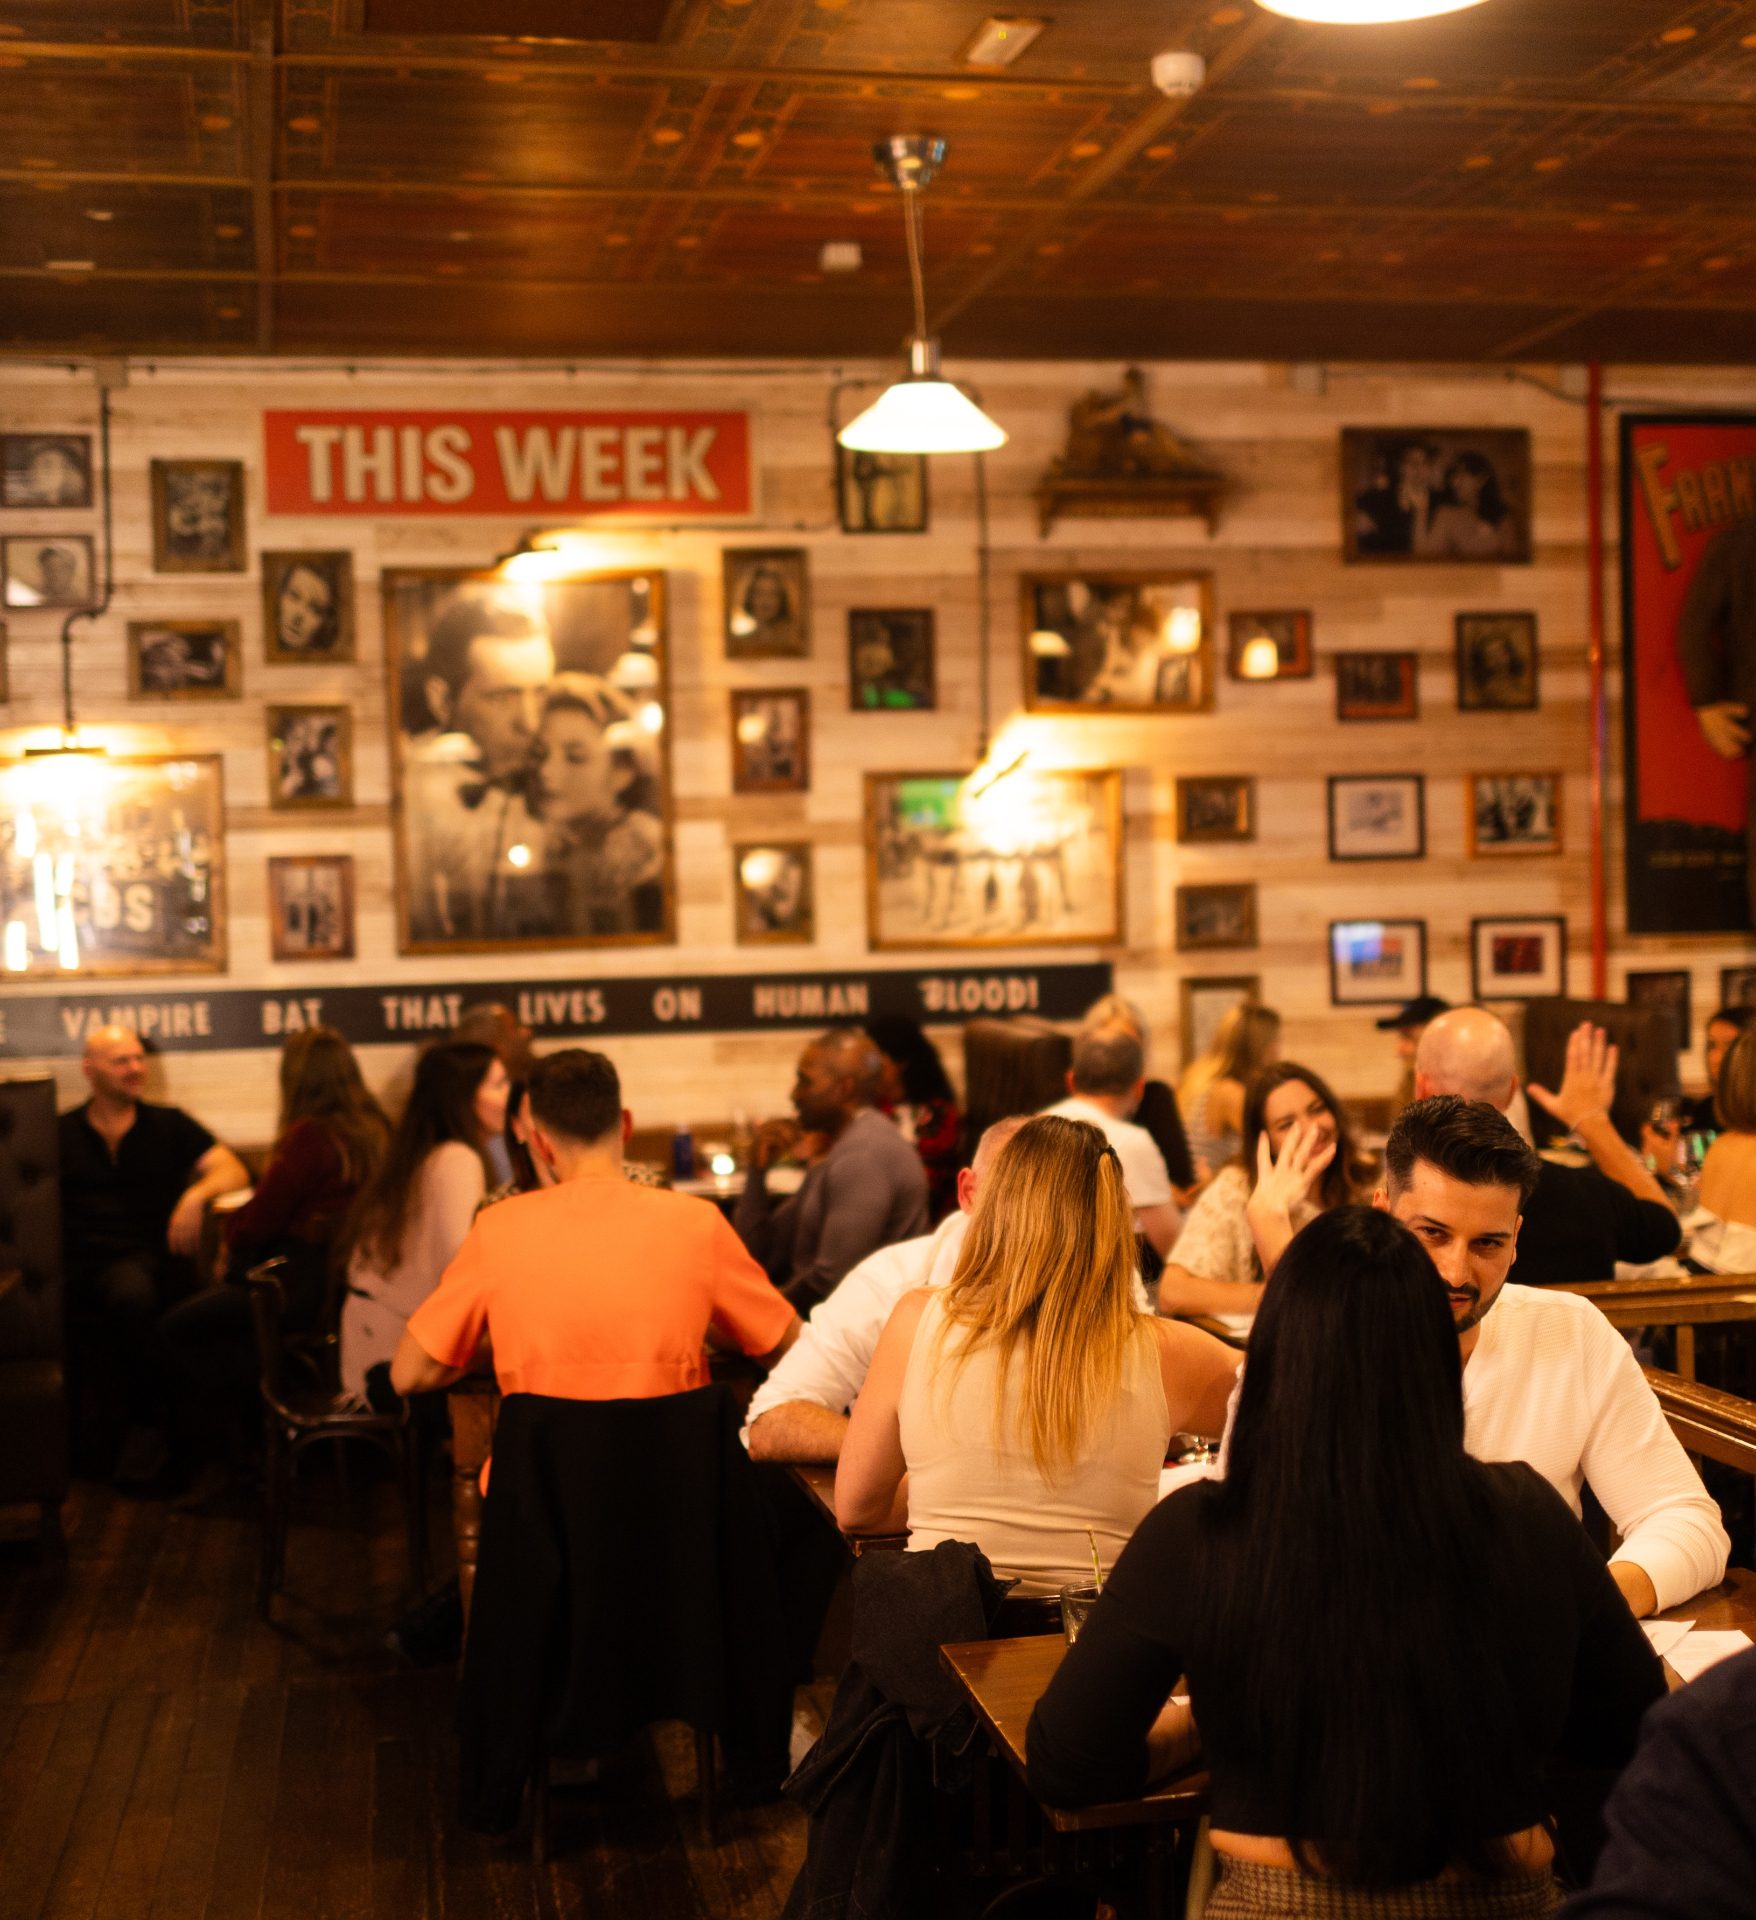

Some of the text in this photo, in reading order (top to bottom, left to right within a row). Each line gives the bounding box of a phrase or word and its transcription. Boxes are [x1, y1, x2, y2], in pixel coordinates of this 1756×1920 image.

[295, 424, 721, 502] THIS WEEK
[62, 977, 1039, 1041] VAMPIRE BAT THAT LIVES ON HUMAN BLOOD!
